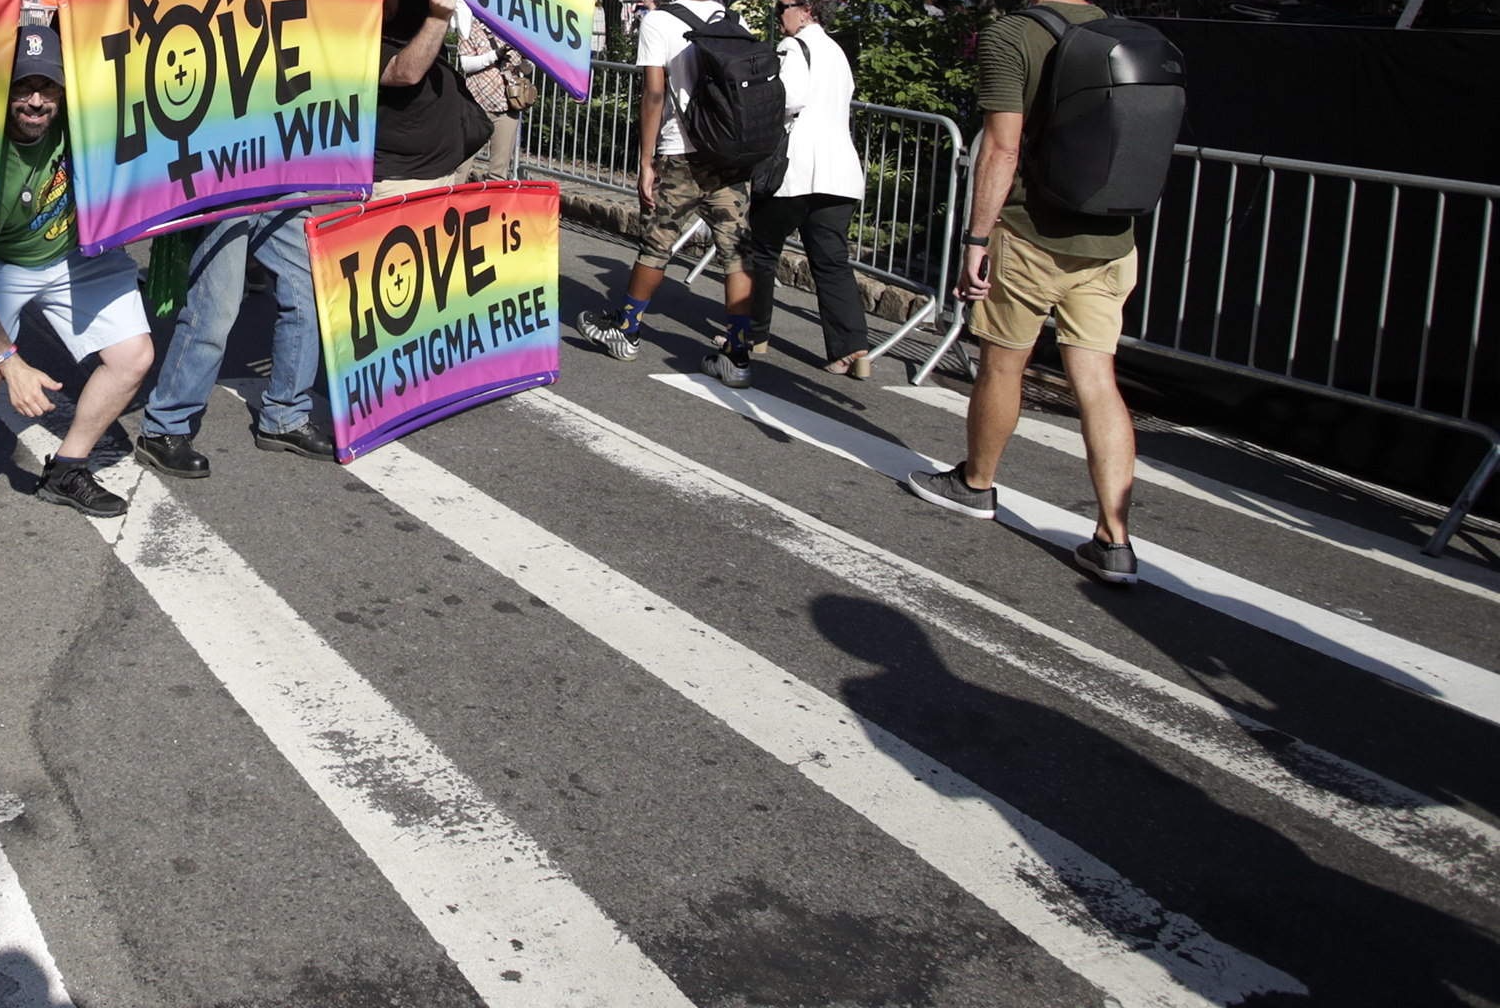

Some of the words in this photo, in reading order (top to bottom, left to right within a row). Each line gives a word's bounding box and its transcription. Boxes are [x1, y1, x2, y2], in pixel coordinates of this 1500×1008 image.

[208, 136, 266, 182] Will
[274, 94, 360, 163] WIN
[340, 205, 497, 361] LOVE
[502, 212, 523, 255] is
[344, 362, 387, 426] HIV
[394, 315, 482, 396] STIGMA
[489, 286, 550, 350] FREE
